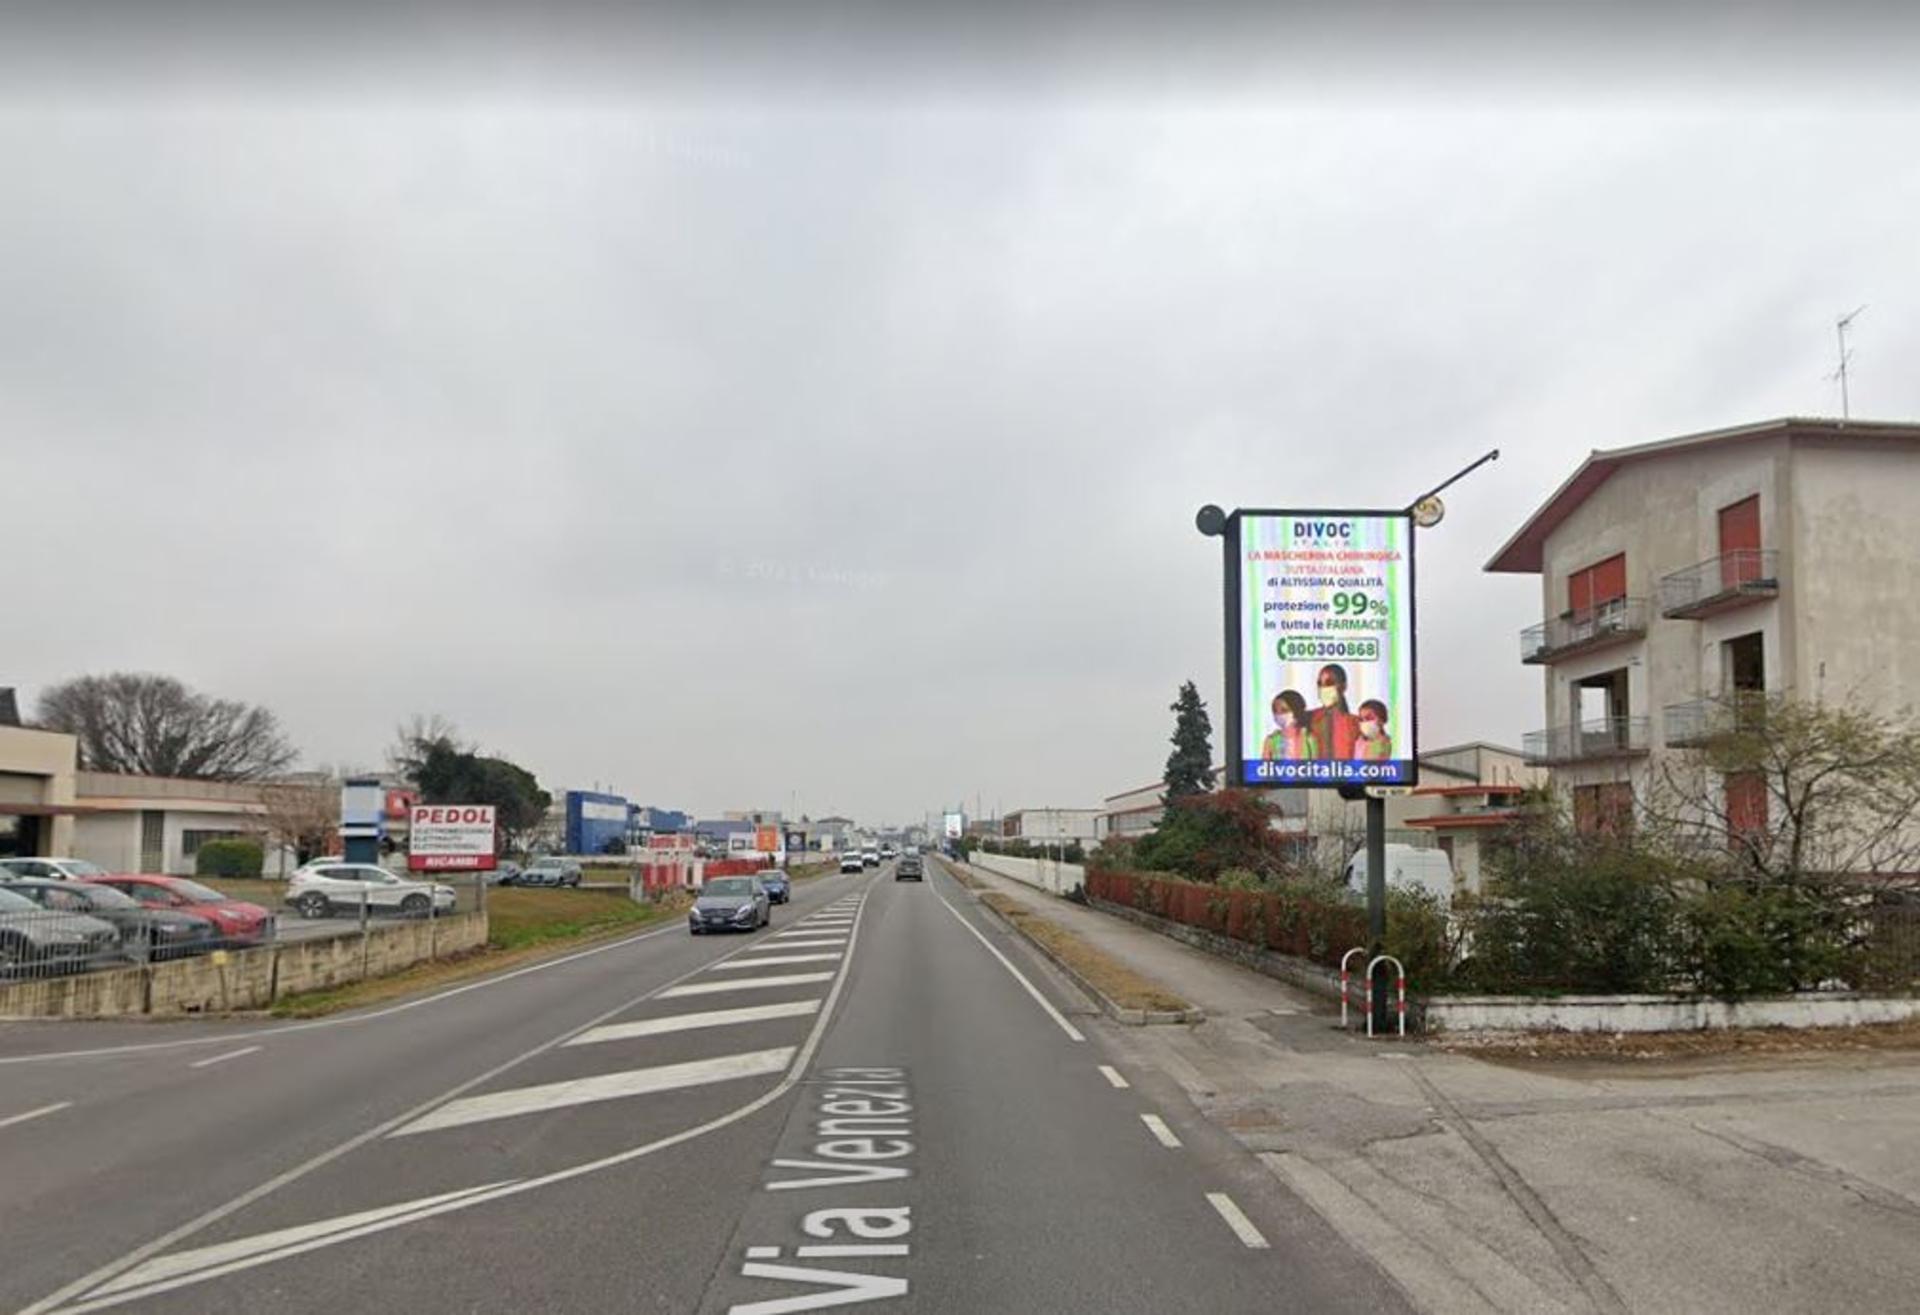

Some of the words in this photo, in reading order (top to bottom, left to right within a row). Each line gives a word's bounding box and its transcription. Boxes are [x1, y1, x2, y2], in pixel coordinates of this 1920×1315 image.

[1294, 523, 1351, 537] DIVOC
[1247, 551, 1261, 561] LA
[1264, 551, 1333, 561] MASCHERINA
[1336, 551, 1402, 561] CHIRURGICA
[1267, 576, 1278, 587] di
[1280, 577, 1335, 587] ALTISSIMA
[1264, 600, 1330, 612] protezione
[1332, 592, 1388, 616] 99%
[1264, 619, 1276, 630] in
[1281, 620, 1311, 630] tutte
[1313, 619, 1324, 630] le
[1326, 619, 1388, 631] FARMACIE
[1287, 642, 1376, 656] 800300868
[1256, 761, 1397, 777] divocitalia.com
[415, 808, 491, 823] PEDOL
[425, 855, 478, 867] RICAMBI
